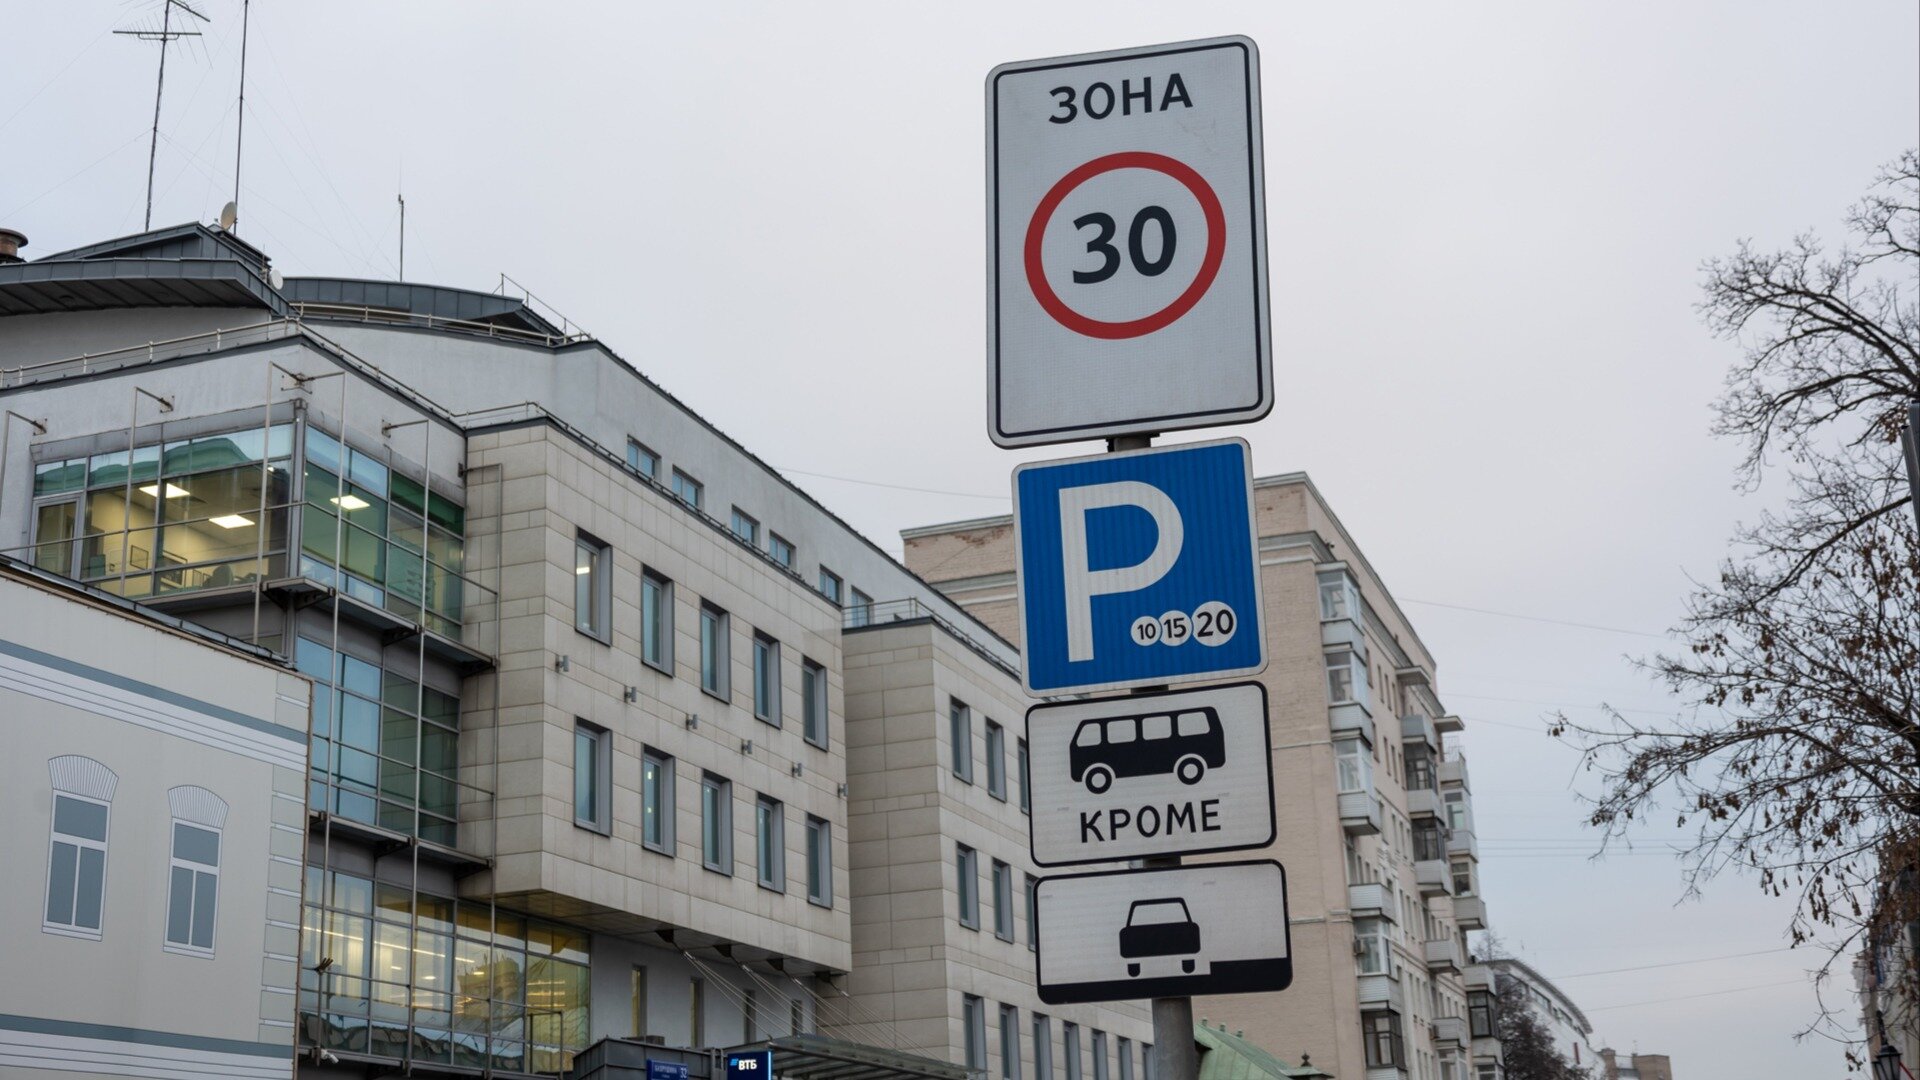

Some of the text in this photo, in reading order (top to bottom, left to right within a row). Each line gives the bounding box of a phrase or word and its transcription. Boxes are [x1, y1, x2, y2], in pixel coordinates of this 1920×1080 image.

[1048, 72, 1194, 125] ЗОНА
[1072, 205, 1177, 285] 30
[1058, 480, 1185, 663] P
[1137, 608, 1235, 641] 10 15 20
[1080, 799, 1222, 844] КРОМЕ
[680, 1067, 688, 1079] 32
[738, 1058, 758, 1071] ВТБ
